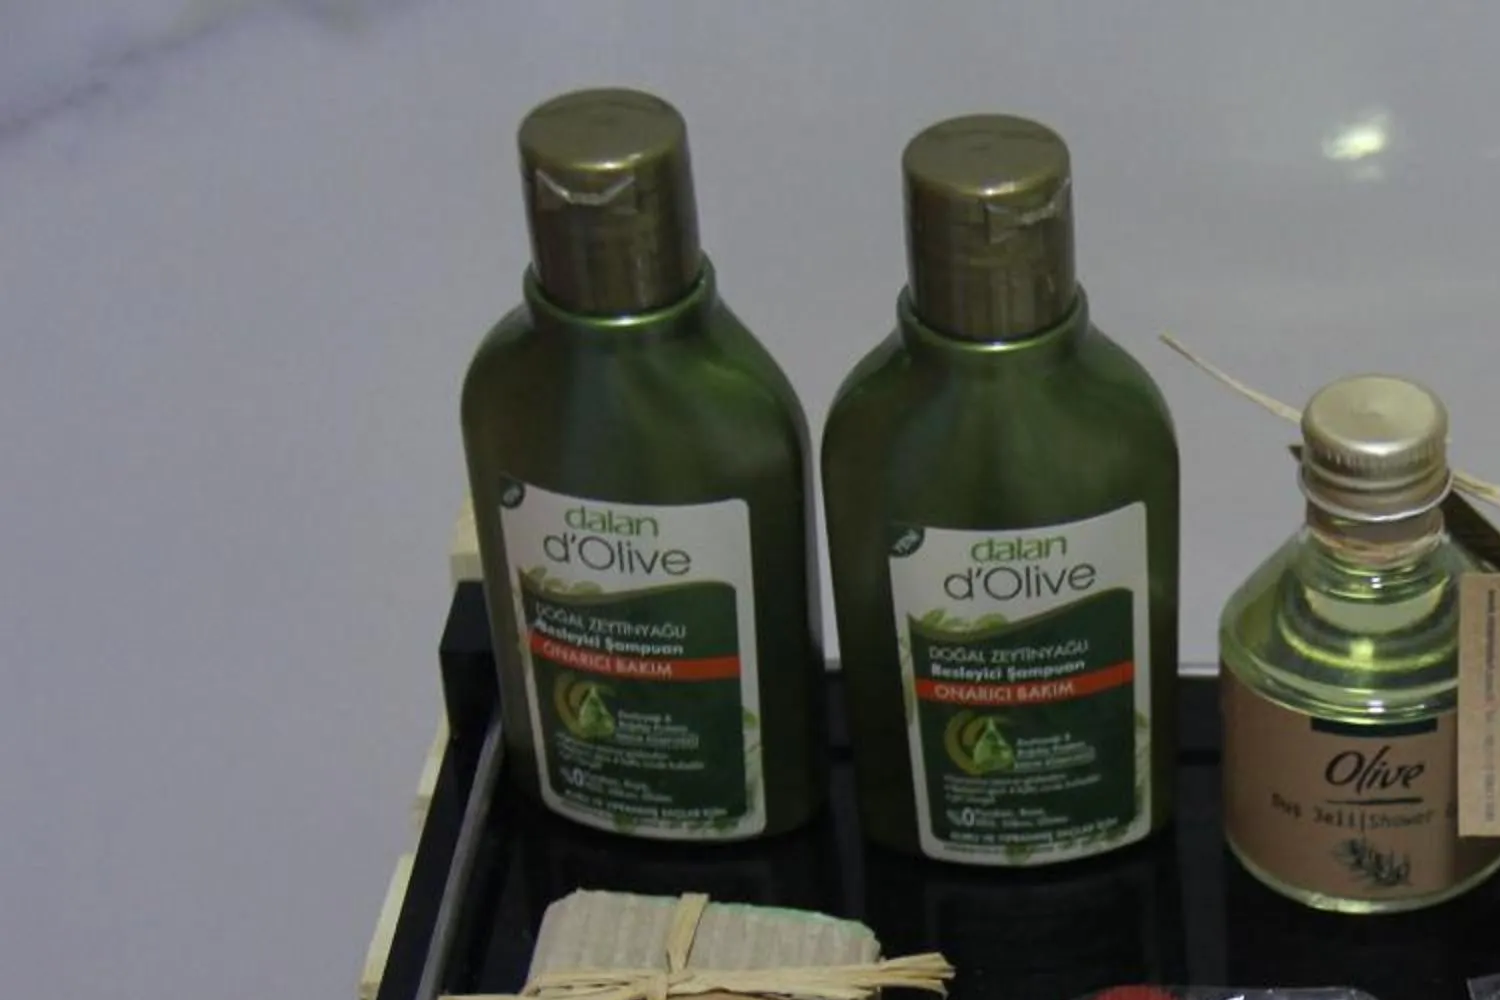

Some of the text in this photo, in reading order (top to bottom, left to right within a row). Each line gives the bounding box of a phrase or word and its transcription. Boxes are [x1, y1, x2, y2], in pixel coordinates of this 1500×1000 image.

[564, 506, 658, 536] dalan
[543, 533, 691, 575] d'Olive
[971, 535, 1067, 563] dalan
[944, 562, 1096, 601] d'Olive
[616, 657, 672, 677] BAKIM
[1006, 660, 1085, 683] Şampuan
[934, 682, 1074, 702] ONARICI BAKIM
[1325, 745, 1425, 794] Olive
